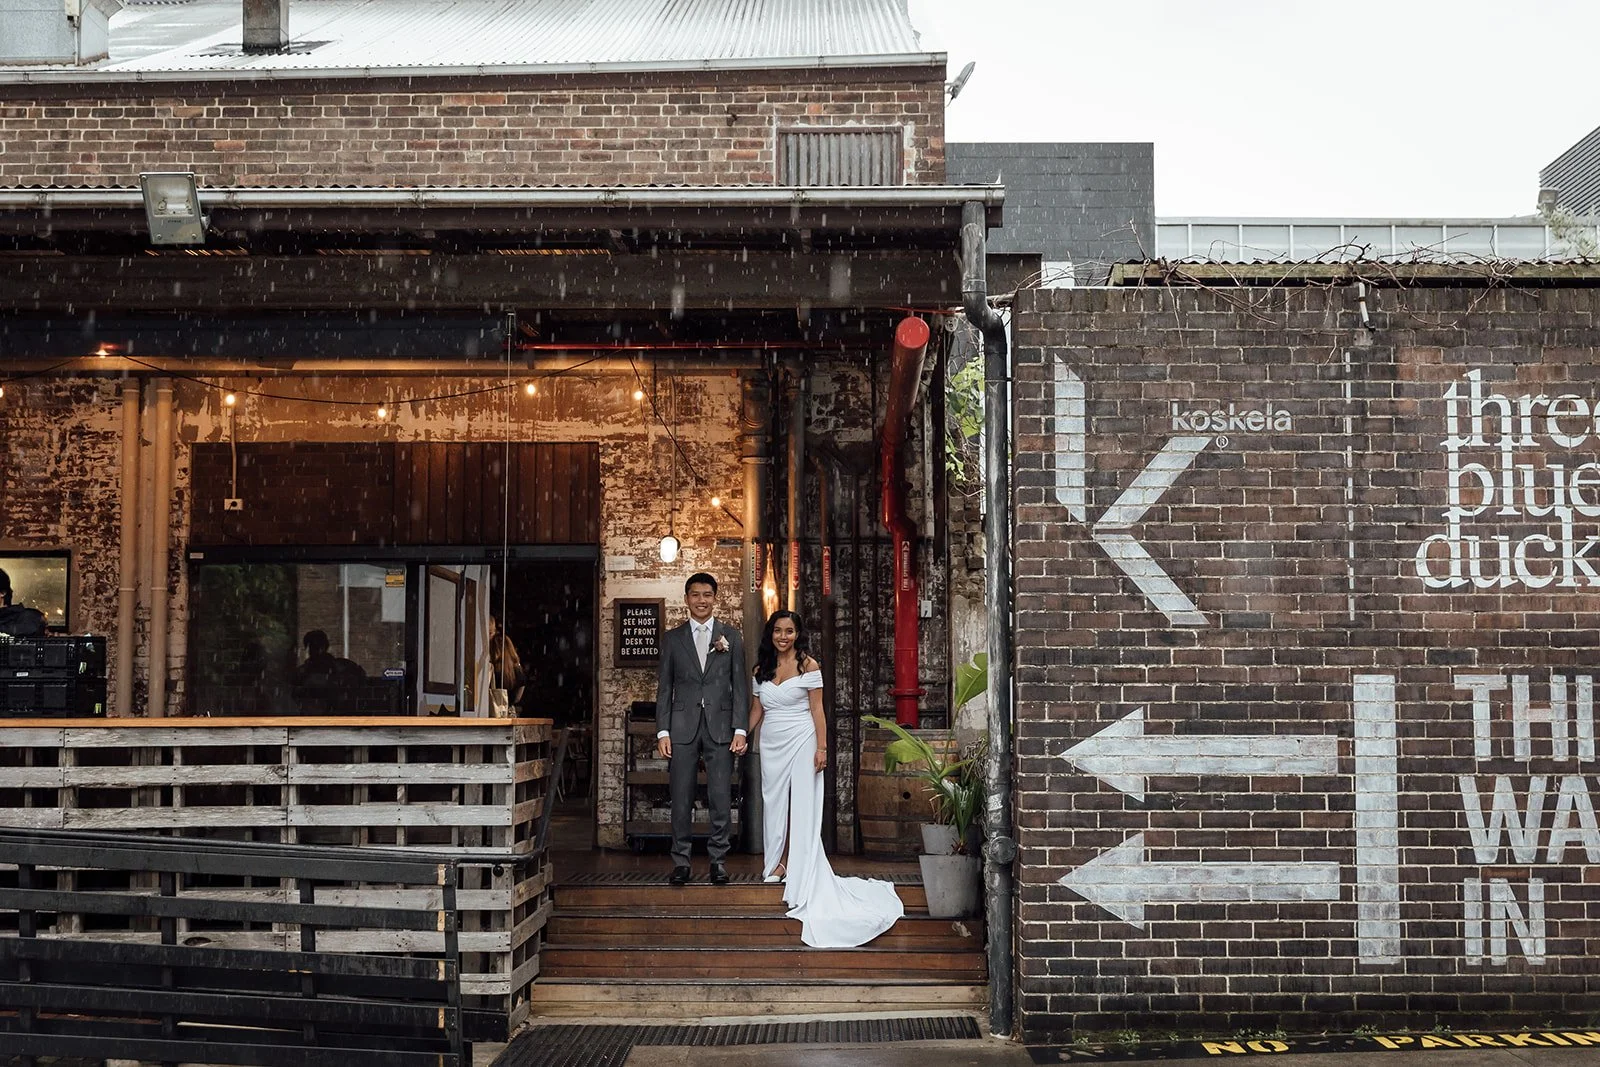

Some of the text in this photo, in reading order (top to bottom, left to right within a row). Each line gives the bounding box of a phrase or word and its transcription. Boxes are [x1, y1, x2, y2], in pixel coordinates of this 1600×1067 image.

[1171, 402, 1292, 432] koskela
[1440, 368, 1600, 448] thre
[1440, 441, 1600, 517] blue
[1415, 506, 1600, 588] duck
[623, 618, 656, 626] SEE HOST
[626, 608, 652, 616] PLEASE
[622, 628, 657, 636] AT FRONT
[625, 638, 655, 646] DESK TO
[621, 648, 631, 656] BE
[1454, 675, 1596, 762] THI
[1459, 775, 1600, 863] WA
[1463, 878, 1546, 966] IN
[1200, 1031, 1600, 1055] NO PARKIN
